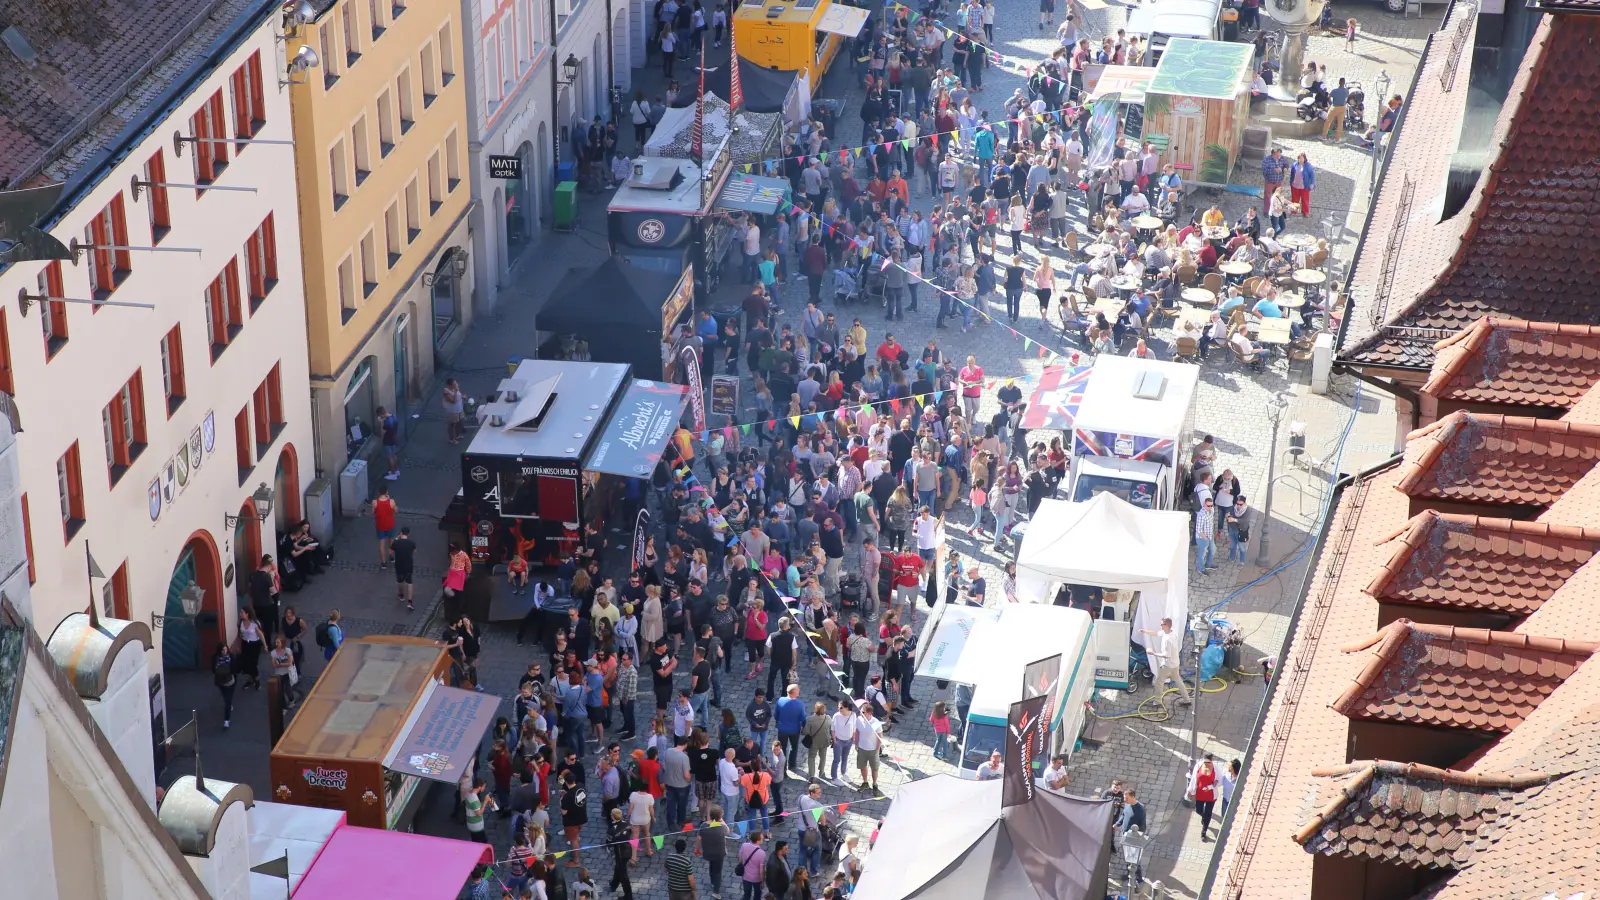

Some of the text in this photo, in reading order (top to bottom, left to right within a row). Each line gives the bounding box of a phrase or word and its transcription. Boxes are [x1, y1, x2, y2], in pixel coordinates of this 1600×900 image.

[492, 159, 518, 169] MATT
[618, 400, 656, 451] Albrecht's
[533, 466, 560, 475] FRÄNKISCH
[560, 468, 579, 476] EHRLICH
[1025, 730, 1034, 761] ORIGINAL
[315, 766, 348, 779] Sweet
[1020, 742, 1032, 800] LOKALSPIESSER
[308, 775, 347, 790] Dreams
